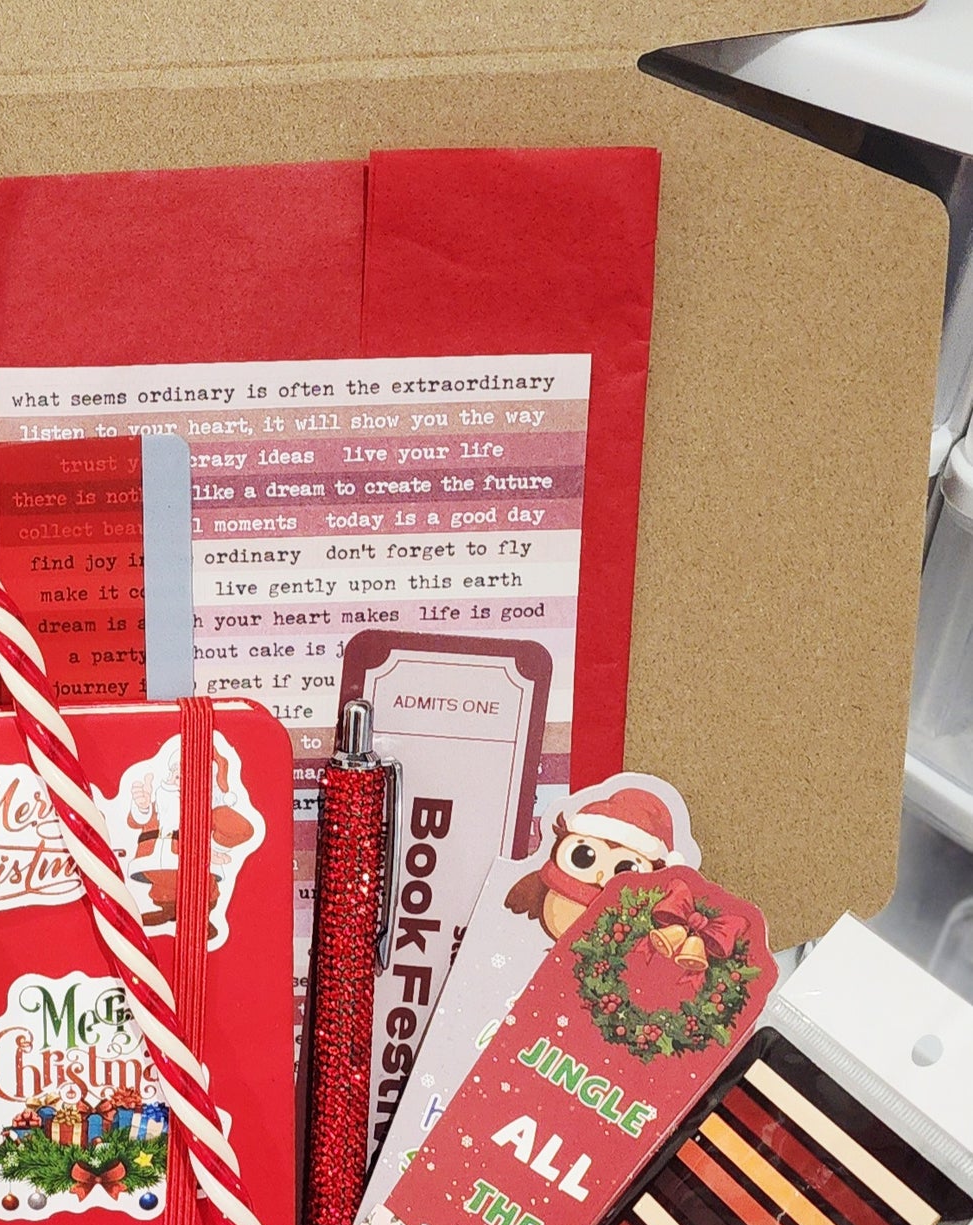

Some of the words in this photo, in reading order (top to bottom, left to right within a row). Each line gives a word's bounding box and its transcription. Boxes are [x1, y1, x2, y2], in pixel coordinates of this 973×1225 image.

[12, 392, 60, 408] what
[71, 391, 127, 406] seems
[138, 386, 235, 405] ordinary
[246, 384, 267, 399] is
[279, 381, 334, 398] often
[346, 380, 380, 396] the
[391, 375, 555, 393] extraordinary
[20, 424, 84, 441] listen
[96, 424, 117, 438] to
[188, 418, 253, 436] heart,
[263, 417, 284, 432] it
[295, 413, 341, 431] will
[350, 413, 400, 429] show
[411, 413, 448, 431] you
[459, 409, 495, 425] the
[505, 409, 545, 427] way
[258, 448, 314, 466] ideas
[343, 446, 388, 463] live
[398, 447, 449, 464] your
[460, 442, 505, 459] life
[60, 456, 117, 473] trust
[193, 485, 234, 501] like
[244, 488, 256, 498] a
[266, 481, 325, 499] dream
[334, 479, 355, 496] to
[364, 477, 432, 494] create
[440, 475, 474, 492] the
[482, 475, 553, 491] future
[12, 492, 67, 508] there
[76, 490, 96, 504] is
[214, 514, 297, 532] moments
[326, 512, 384, 531] today
[394, 511, 416, 525] is
[427, 513, 440, 525] a
[451, 508, 496, 528] good
[507, 506, 545, 525] day
[19, 523, 93, 541] collect
[204, 548, 301, 565] ordinary
[326, 543, 376, 561] don't
[386, 541, 455, 559] forget
[466, 541, 486, 556] to
[498, 540, 532, 557] fly
[31, 555, 74, 571] find
[85, 556, 117, 572] joy
[40, 587, 88, 602] make
[99, 586, 118, 600] it
[216, 581, 258, 596] live
[269, 578, 336, 598] gently
[349, 579, 396, 594] upon
[408, 574, 452, 590] this
[463, 573, 522, 588] earth
[214, 614, 262, 630] your
[273, 610, 331, 626] heart
[341, 607, 399, 624] makes
[419, 605, 460, 621] life
[470, 604, 490, 619] is
[501, 603, 545, 622] good
[38, 617, 96, 633] dream
[106, 616, 126, 630] is
[68, 652, 80, 664] a
[92, 648, 146, 666] party
[193, 645, 238, 659] hout
[249, 642, 295, 657] cake
[305, 641, 326, 656] is
[54, 681, 129, 698] journey
[207, 675, 262, 693] great
[272, 674, 291, 688] if
[302, 674, 335, 690] you
[275, 705, 313, 719] life
[393, 695, 459, 713] ADMITS
[462, 699, 500, 715] ONE
[301, 735, 321, 750] to
[395, 796, 454, 954] Book
[519, 1038, 653, 1138] JINGLE
[490, 1115, 593, 1202] ALL
